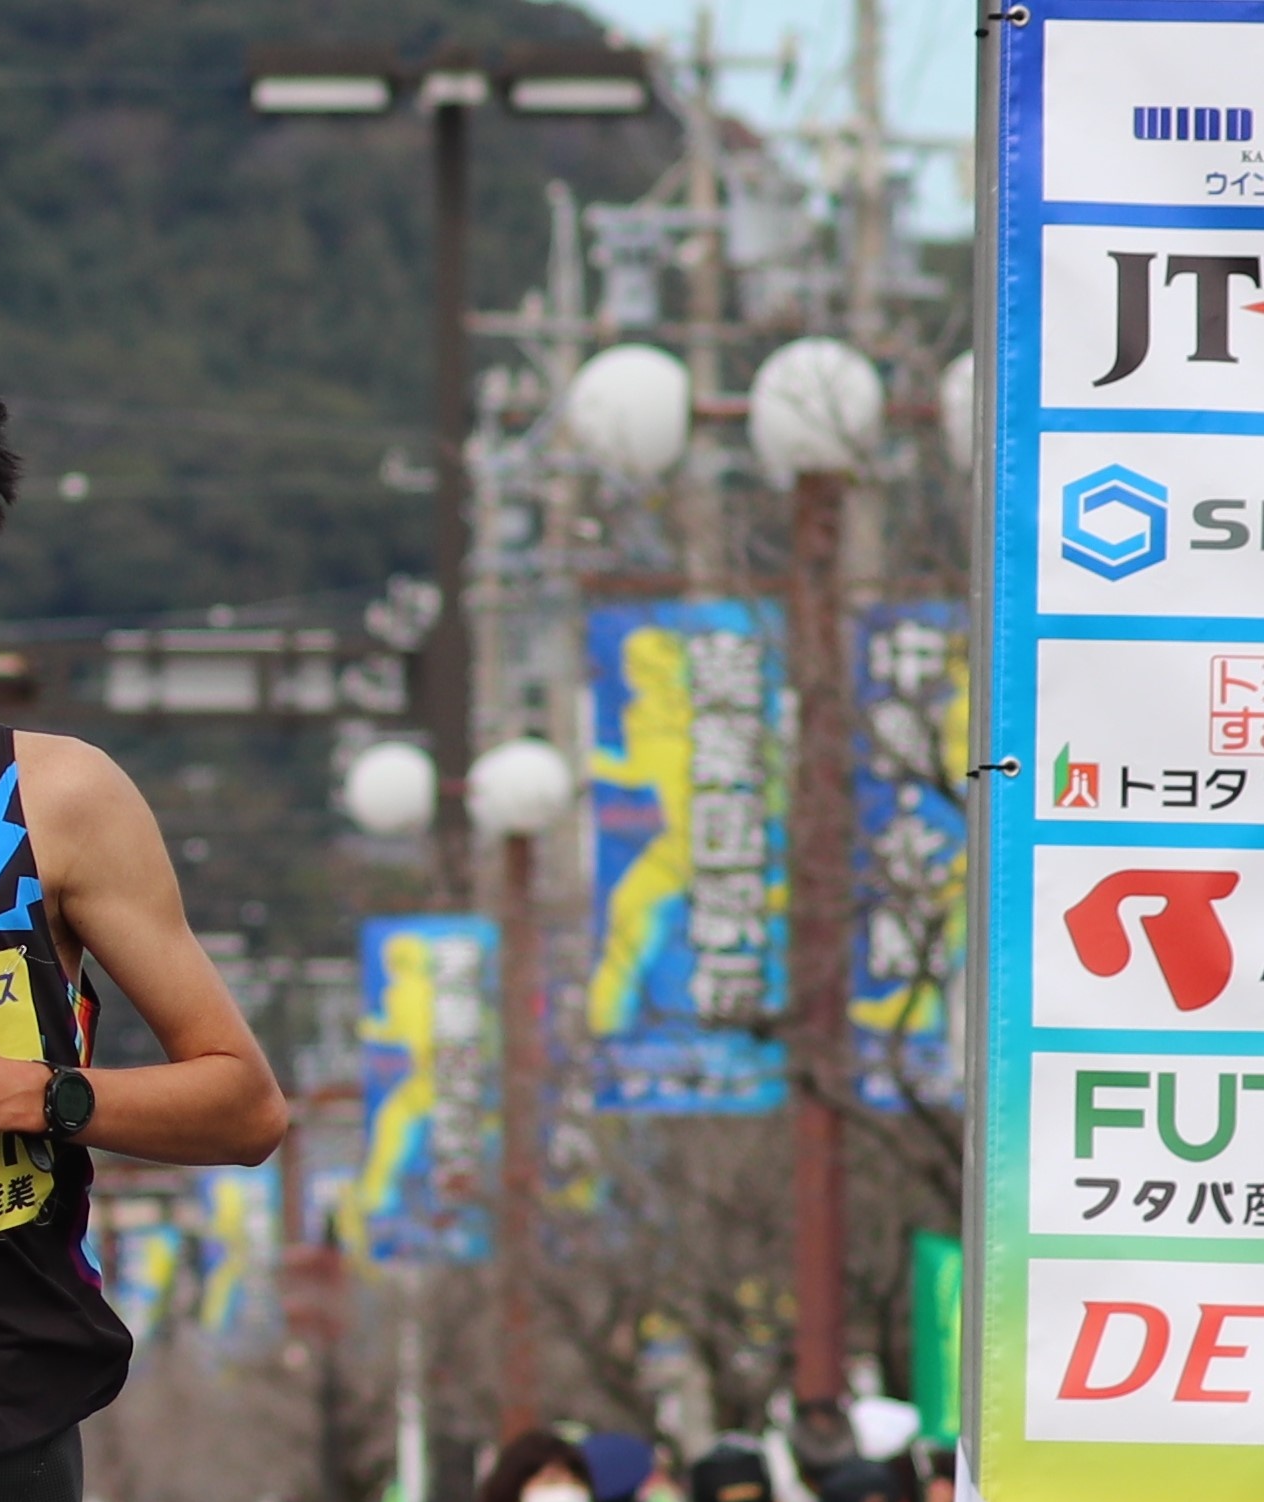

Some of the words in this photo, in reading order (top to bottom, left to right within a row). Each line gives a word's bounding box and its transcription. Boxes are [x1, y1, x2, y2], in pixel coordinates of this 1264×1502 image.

[1133, 106, 1253, 141] WIND
[1190, 499, 1264, 551] S
[1220, 660, 1264, 705] ト
[1120, 766, 1248, 811] トヨタ
[1056, 1300, 1264, 1403] DE
